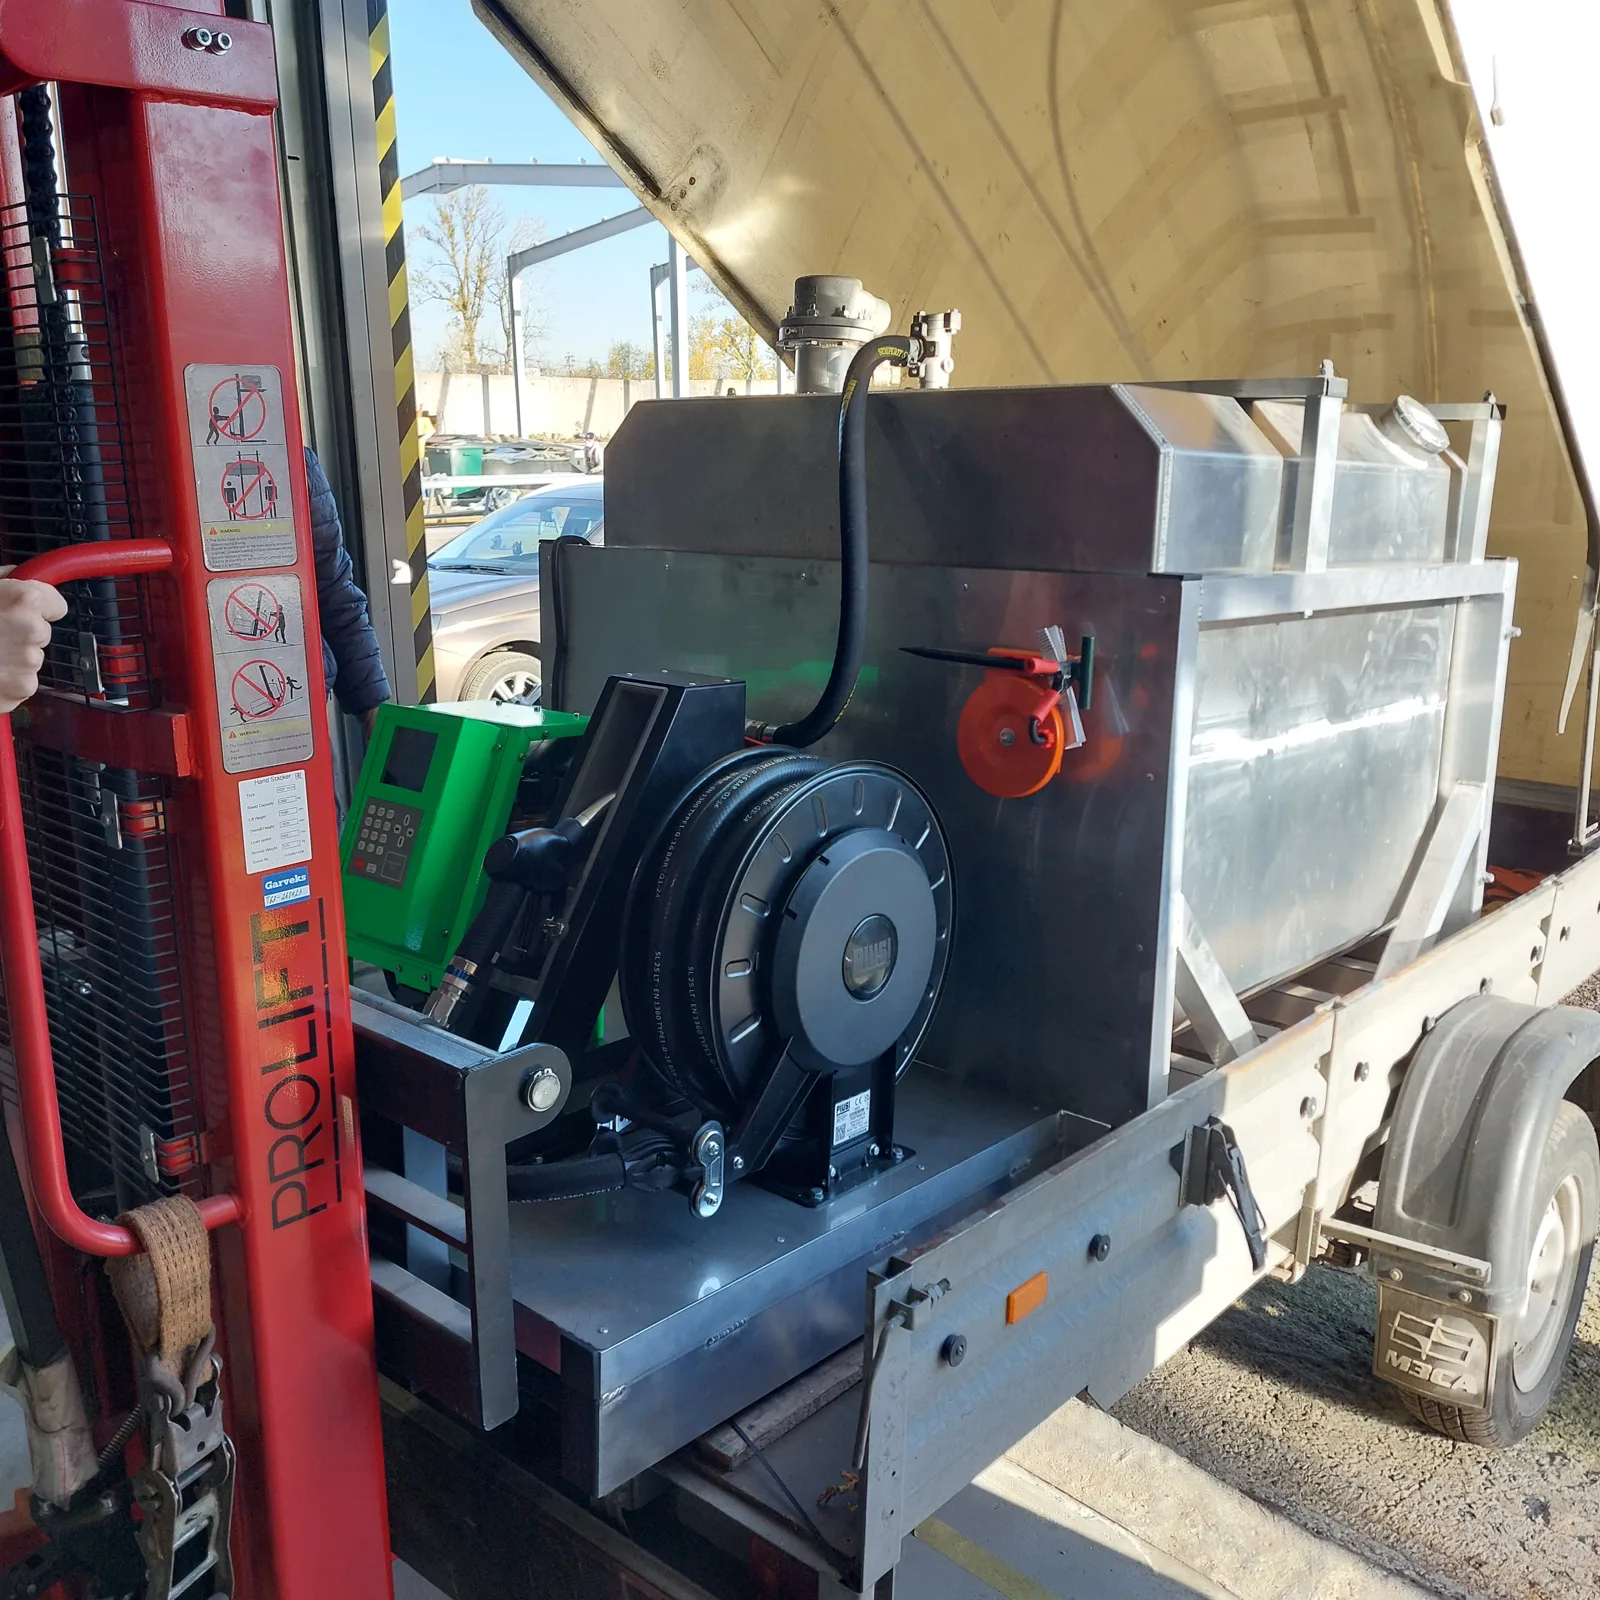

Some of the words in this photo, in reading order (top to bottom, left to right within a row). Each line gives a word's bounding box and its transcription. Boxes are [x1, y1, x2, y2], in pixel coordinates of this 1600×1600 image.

[254, 777, 270, 785] Hand
[270, 774, 291, 782] Stacker
[265, 874, 307, 890] Garveks
[249, 913, 327, 1230] PROLIFT
[836, 1101, 851, 1113] PIUSI
[1385, 1348, 1478, 1395] МЗСА
